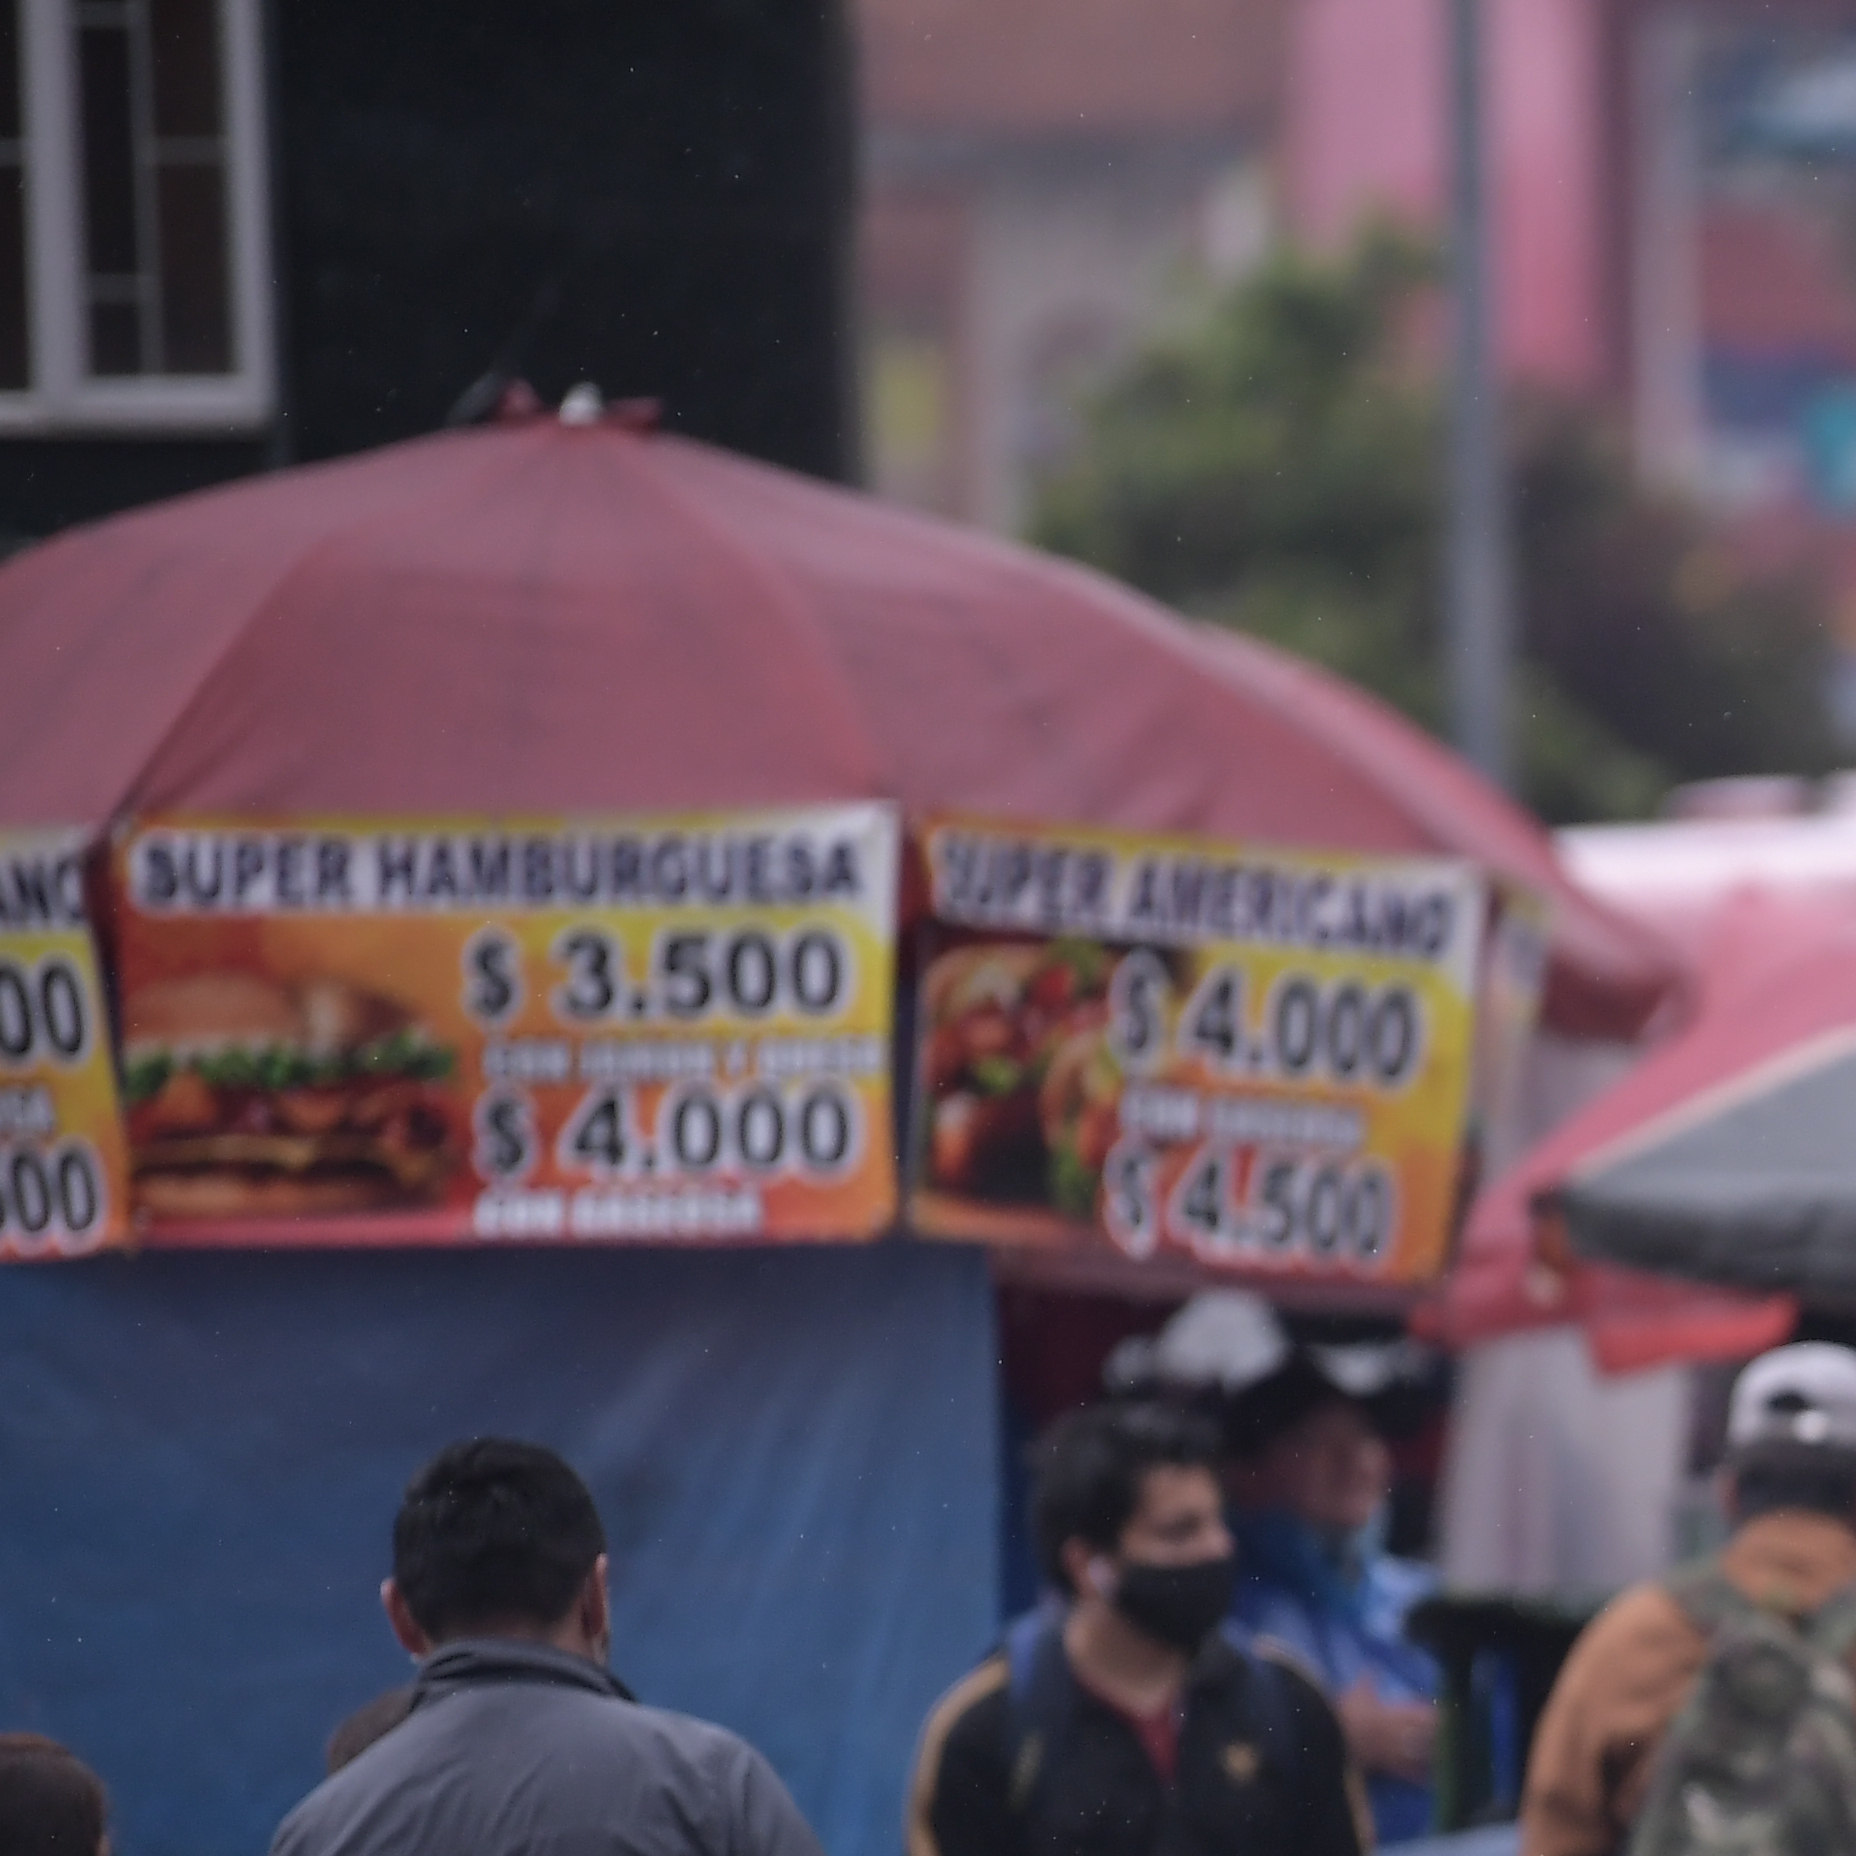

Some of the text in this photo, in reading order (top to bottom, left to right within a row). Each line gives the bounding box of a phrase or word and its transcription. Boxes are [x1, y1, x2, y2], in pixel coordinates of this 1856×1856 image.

[145, 834, 863, 903] SUPER HAMBURGUESA
[942, 839, 1452, 957] SUPER AMERICANO
[564, 928, 845, 1018] 3.500
[1191, 972, 1420, 1088] 4.000
[573, 1090, 851, 1172] 4.000
